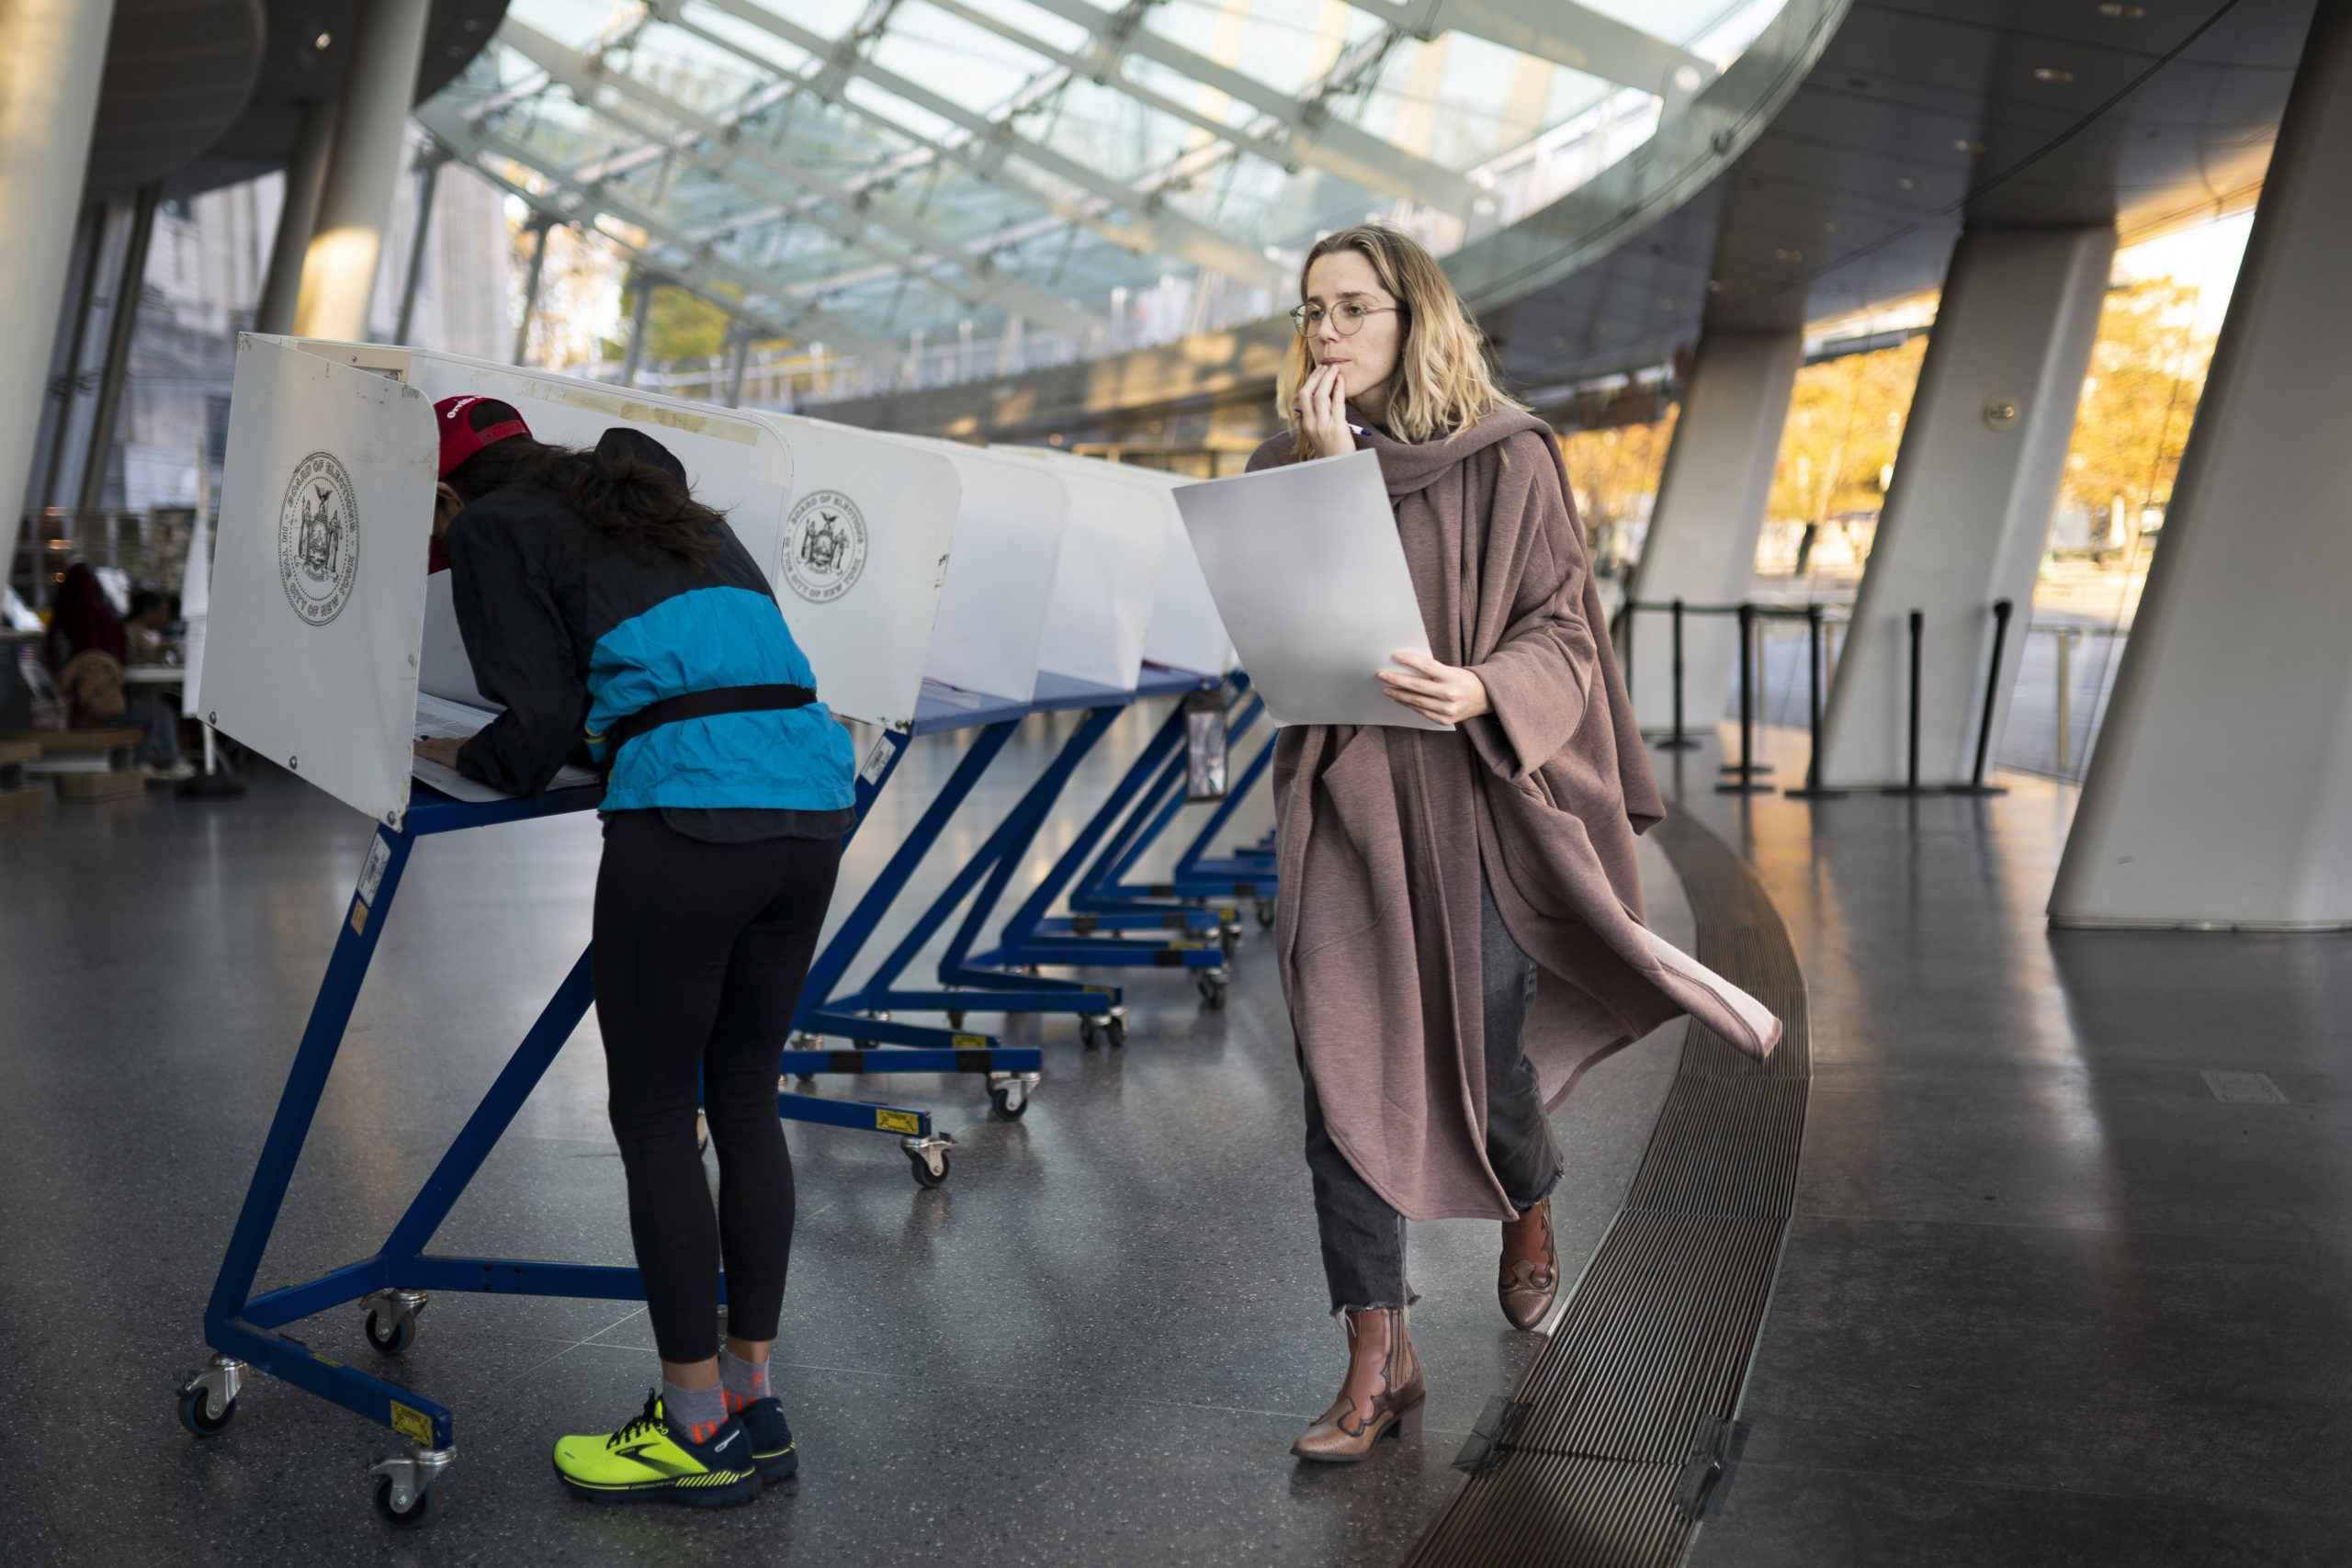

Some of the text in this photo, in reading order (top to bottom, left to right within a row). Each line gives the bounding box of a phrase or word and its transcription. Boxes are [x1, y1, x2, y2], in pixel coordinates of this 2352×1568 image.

[288, 459, 356, 534] BOARD OF ELECTIONS
[791, 495, 864, 544] BOARD OF ELECTIONS
[282, 526, 355, 617] IN THE CITY OF NEW YORK
[791, 574, 809, 593] CITY
[808, 589, 820, 597] OF
[822, 583, 842, 598] NEW
[842, 558, 861, 584] YORK
